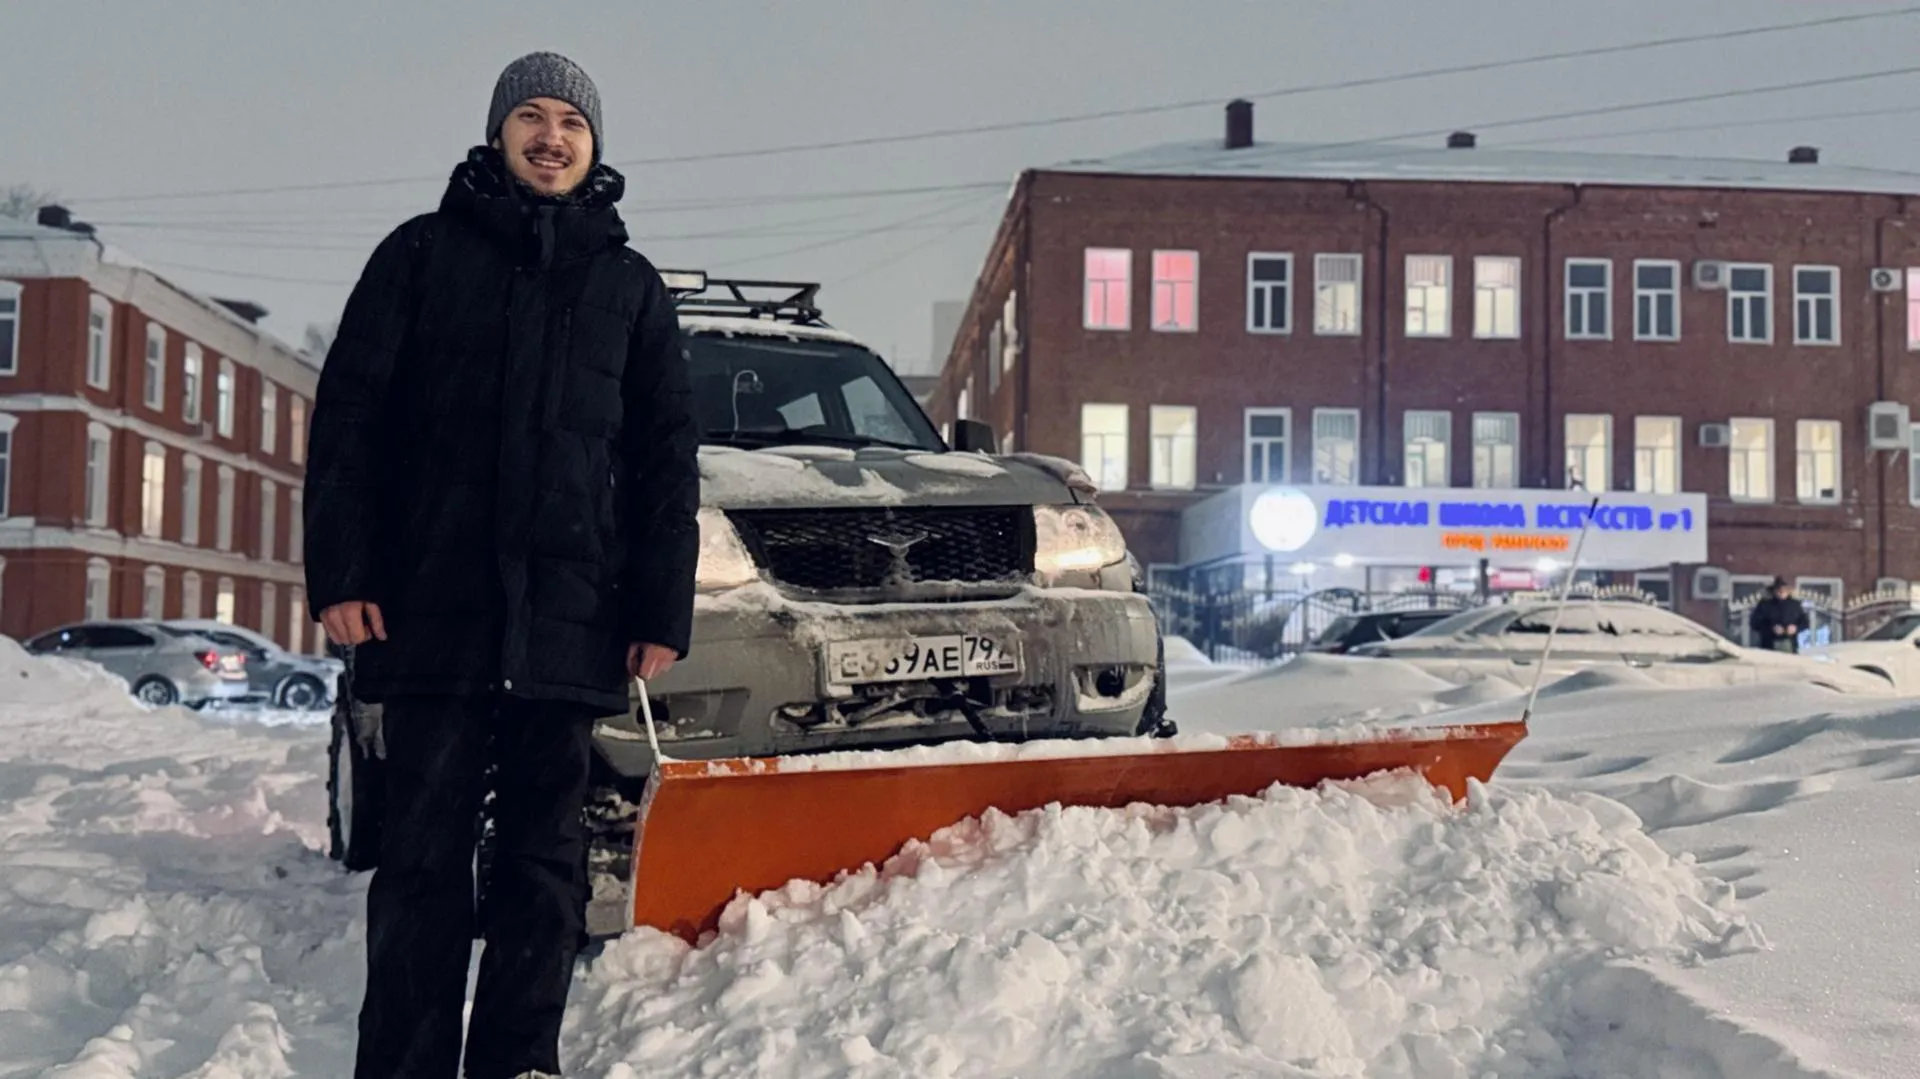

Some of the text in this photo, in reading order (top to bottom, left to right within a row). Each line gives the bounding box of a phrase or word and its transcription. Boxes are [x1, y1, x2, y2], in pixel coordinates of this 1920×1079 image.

[1324, 499, 1429, 528] ДЕТСКАЯ
[1439, 502, 1526, 529] ШКОЛА
[1536, 503, 1653, 531] ИСКУССТВ
[976, 661, 998, 671] RUS
